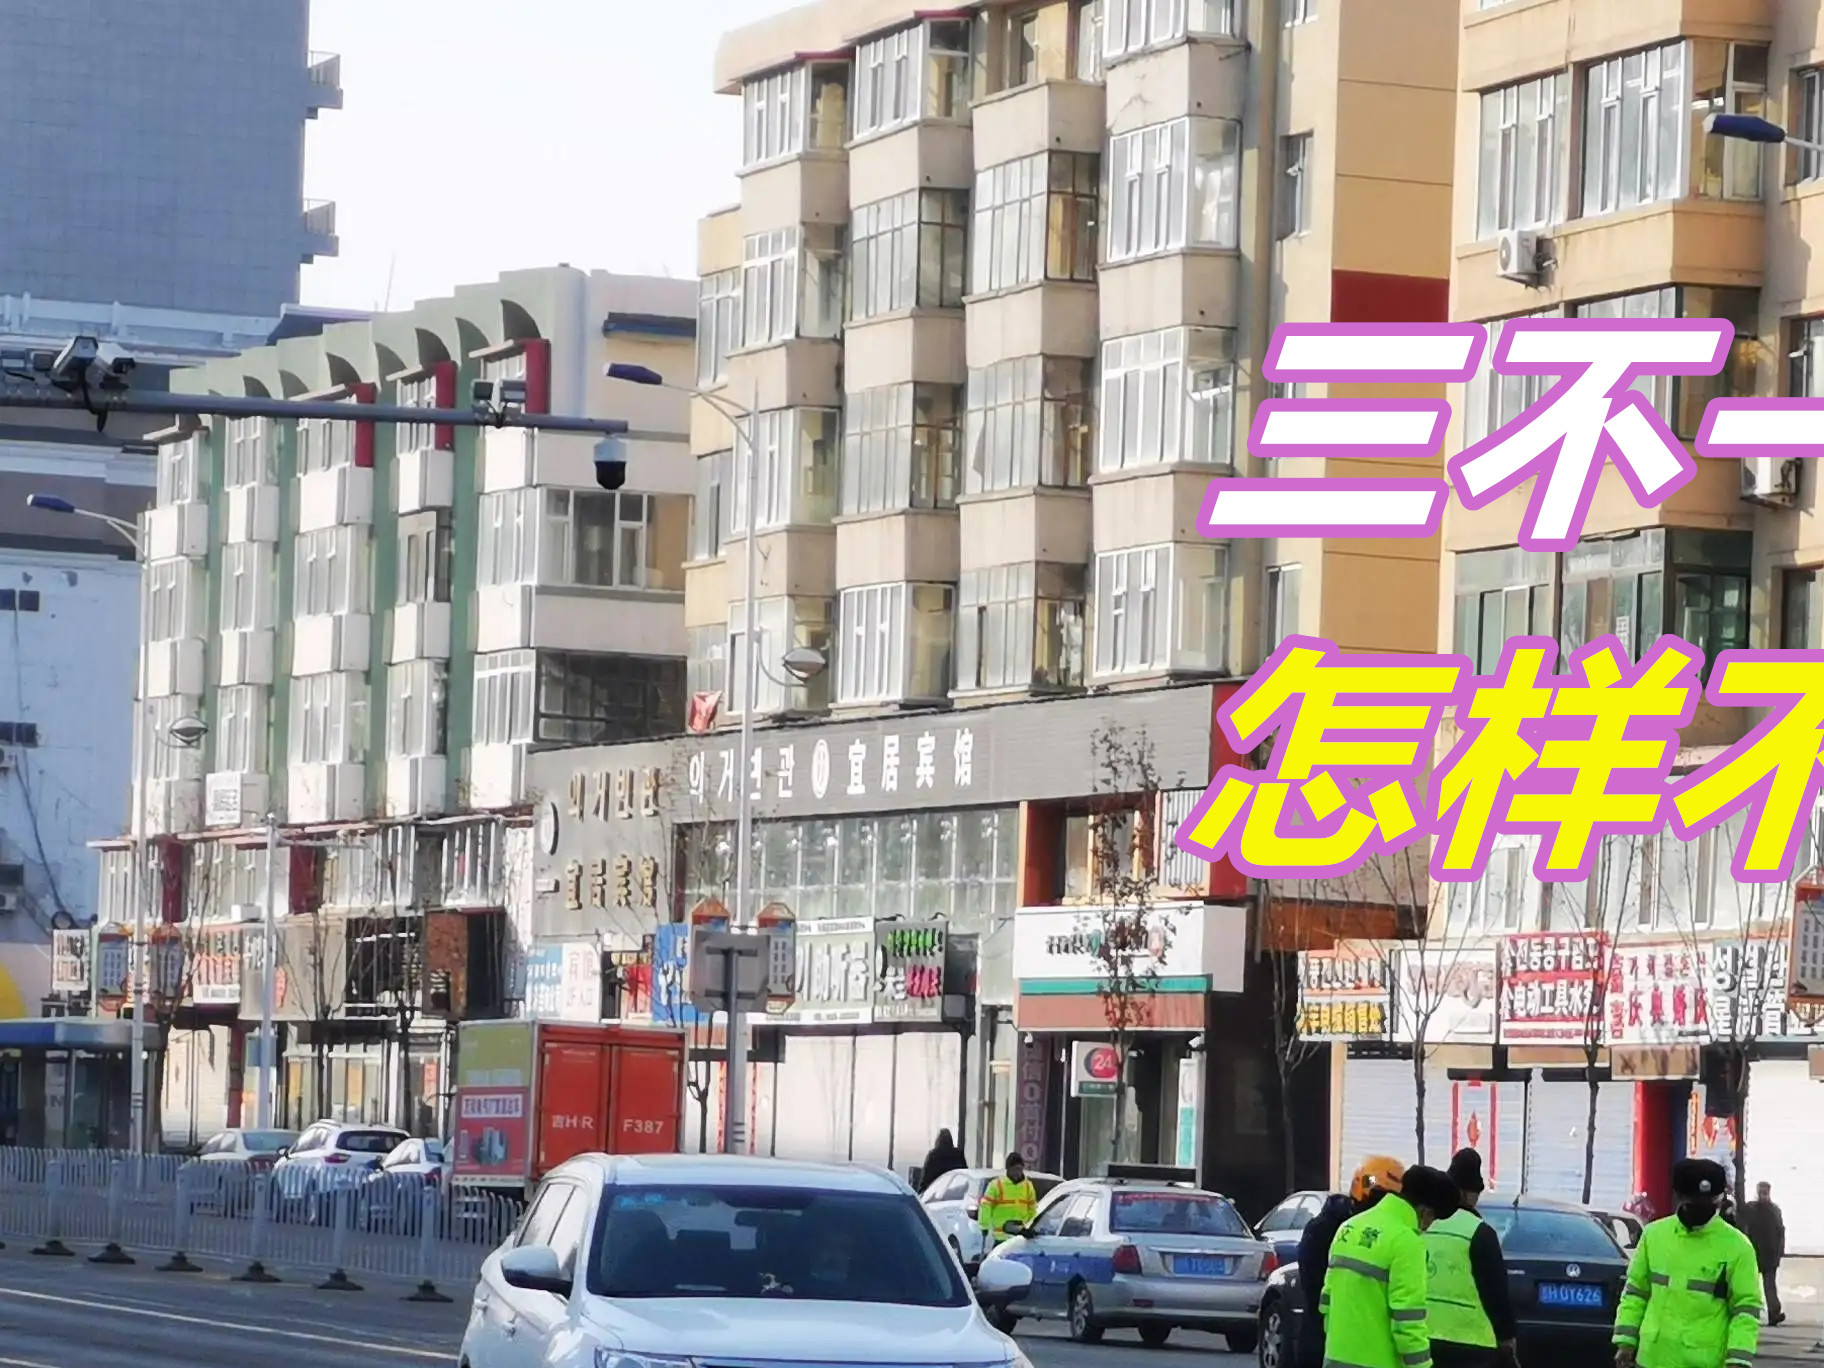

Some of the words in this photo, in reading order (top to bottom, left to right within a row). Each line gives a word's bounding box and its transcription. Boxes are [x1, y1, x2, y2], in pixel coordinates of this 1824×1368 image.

[847, 728, 974, 796] 宜居宾馆
[622, 1118, 665, 1135] F387
